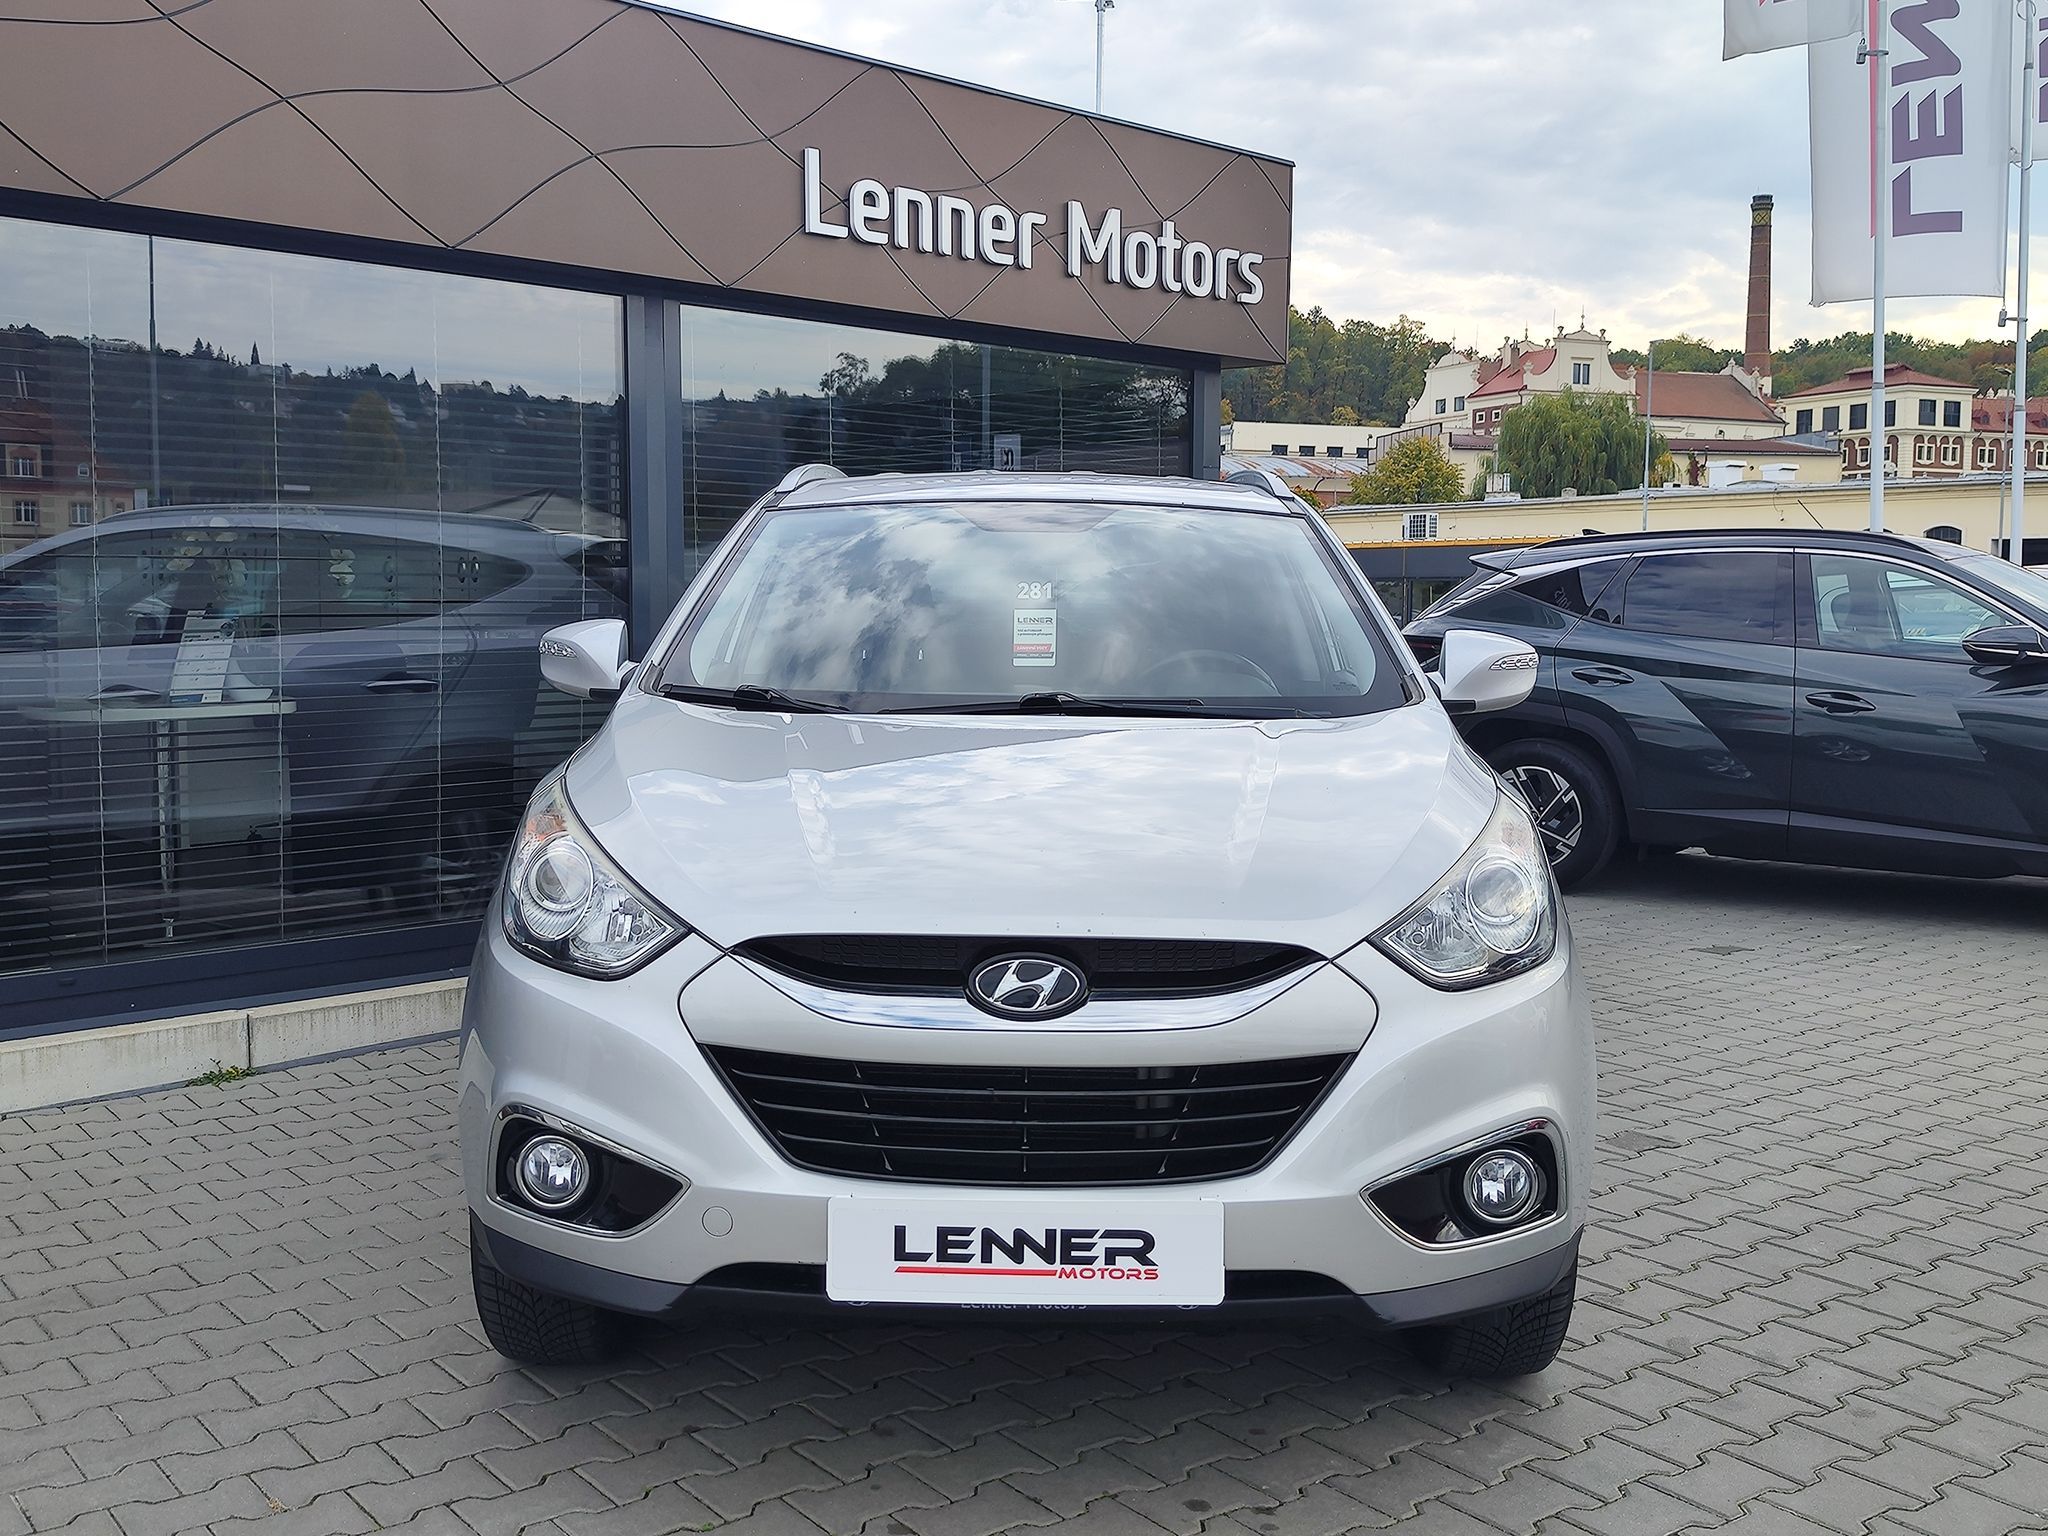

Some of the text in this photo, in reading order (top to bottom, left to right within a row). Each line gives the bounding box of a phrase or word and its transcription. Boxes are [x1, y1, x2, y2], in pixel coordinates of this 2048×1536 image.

[804, 147, 1264, 304] Lenner Motors
[1017, 582, 1052, 599] 281
[894, 1225, 1159, 1266] LENNER
[1058, 1267, 1159, 1280] MOTORS
